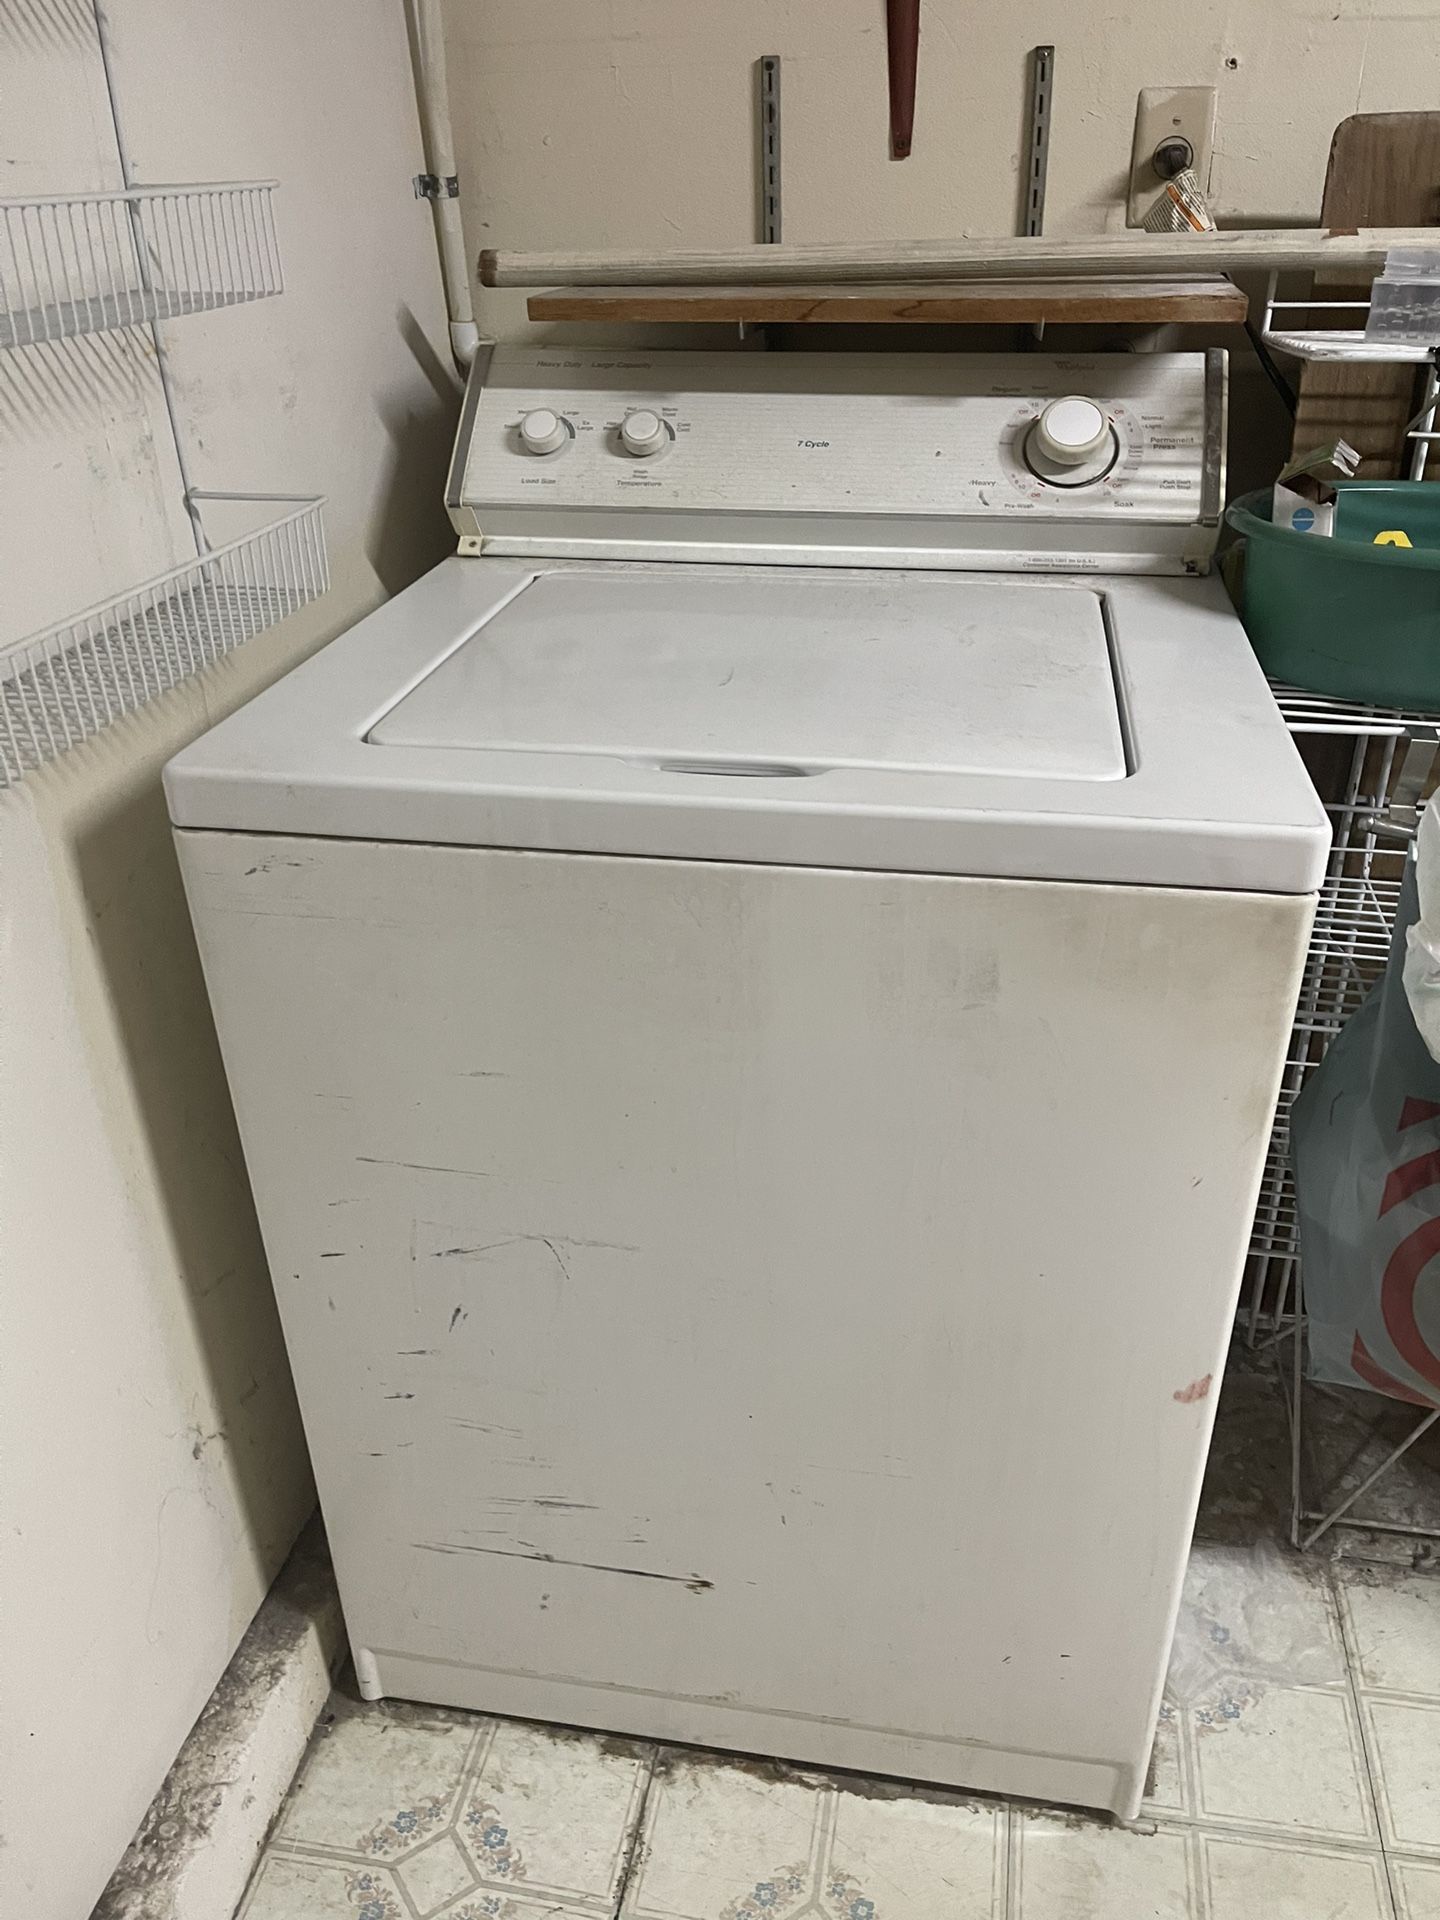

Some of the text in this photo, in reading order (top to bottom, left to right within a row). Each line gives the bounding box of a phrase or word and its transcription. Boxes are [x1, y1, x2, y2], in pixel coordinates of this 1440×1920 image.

[591, 361, 615, 369] Large
[616, 361, 651, 369] Capacity
[804, 440, 830, 449] Cycle
[971, 479, 996, 487] Heavy
